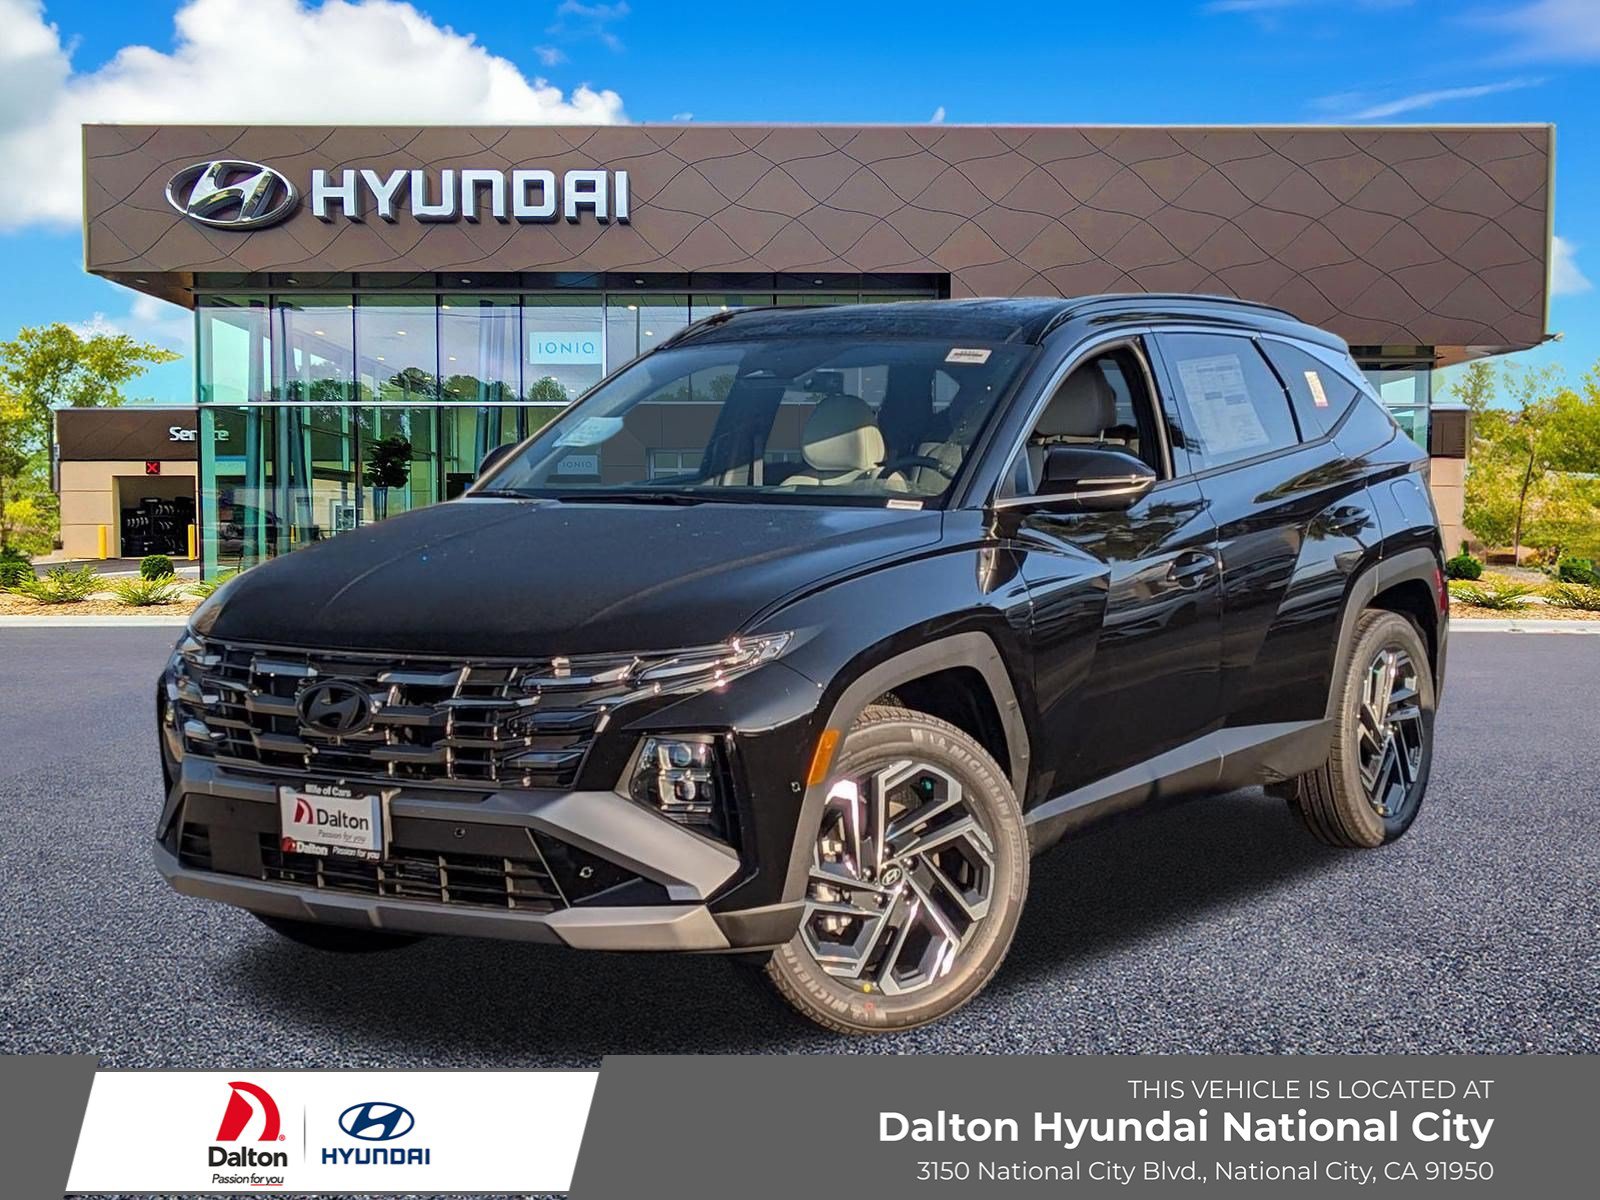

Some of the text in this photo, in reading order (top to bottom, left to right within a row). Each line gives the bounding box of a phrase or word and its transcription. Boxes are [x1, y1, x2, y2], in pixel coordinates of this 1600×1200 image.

[312, 169, 629, 223] HYUNDAI
[538, 341, 595, 355] IONIQ
[322, 786, 331, 796] of
[316, 808, 369, 831] Dalton
[297, 842, 328, 856] Dalton
[357, 850, 366, 858] for
